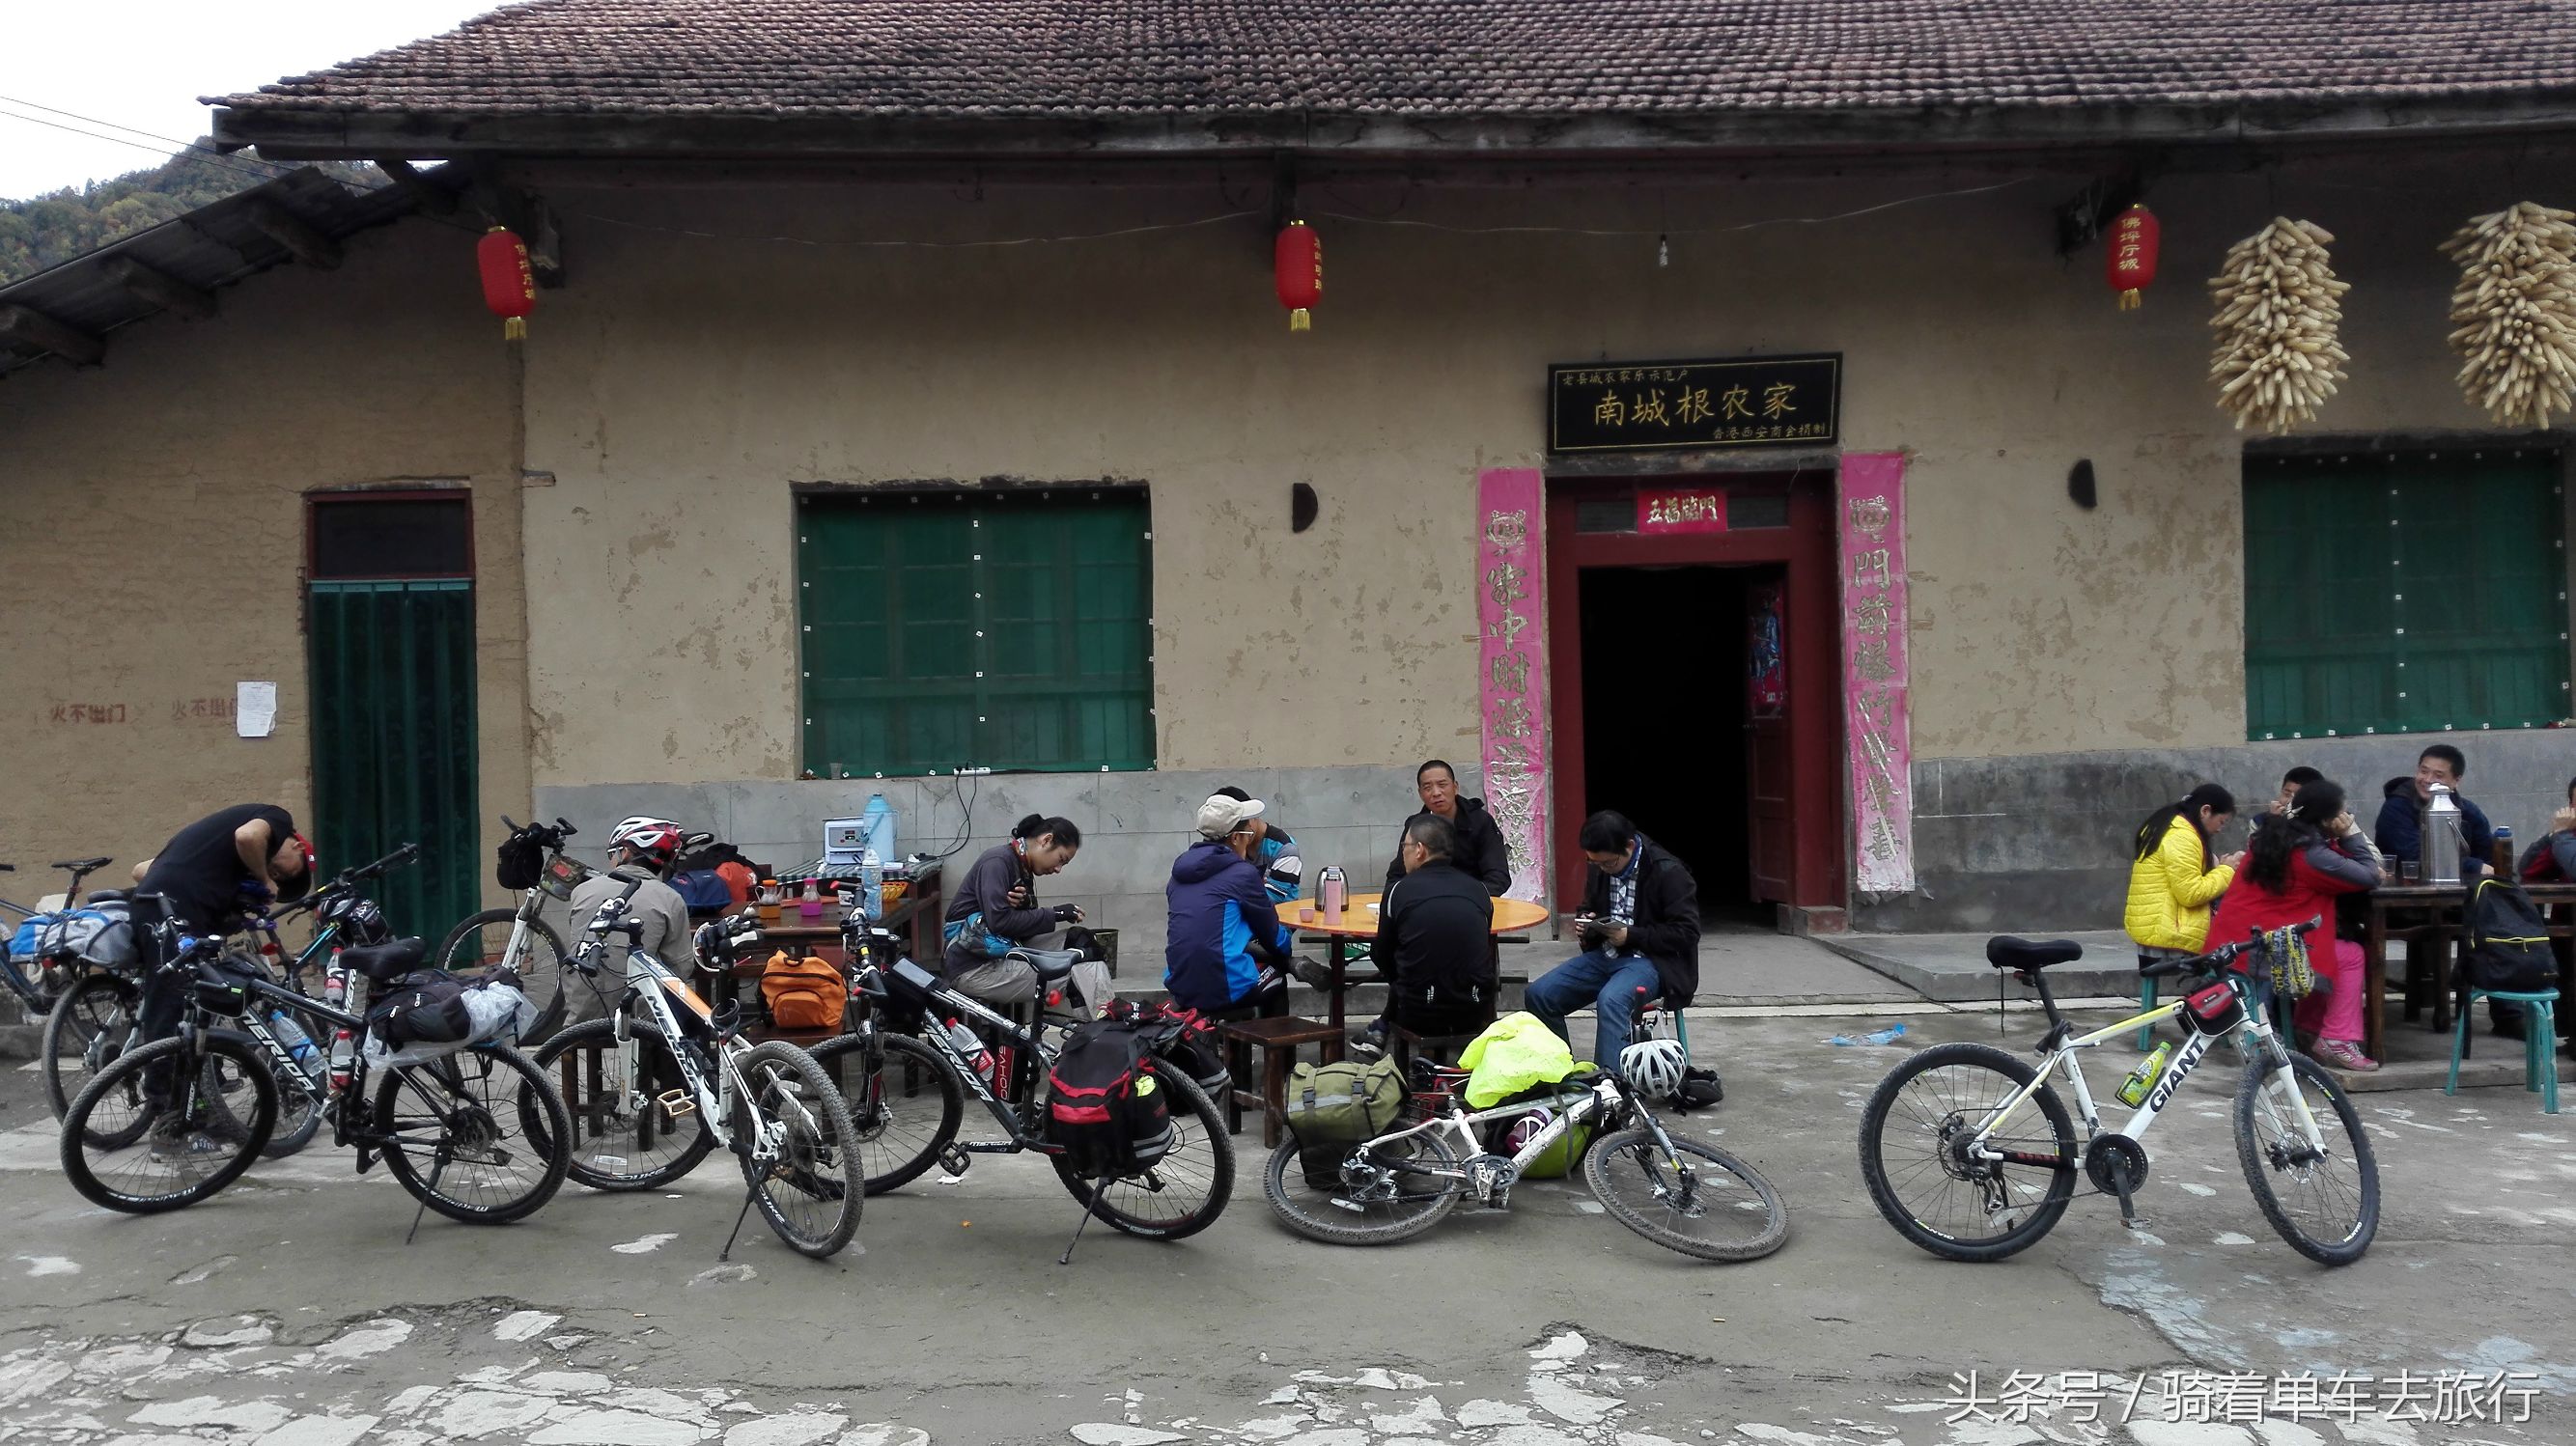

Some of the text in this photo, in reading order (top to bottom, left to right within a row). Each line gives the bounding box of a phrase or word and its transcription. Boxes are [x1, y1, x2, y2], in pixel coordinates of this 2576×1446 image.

[1594, 382, 1798, 427] 南城根农家
[50, 703, 126, 724] 火不出门
[171, 697, 238, 720] 火不出
[937, 1024, 953, 1042] 600
[998, 1045, 1009, 1100] SAHOO
[2149, 1035, 2205, 1113] GIANT
